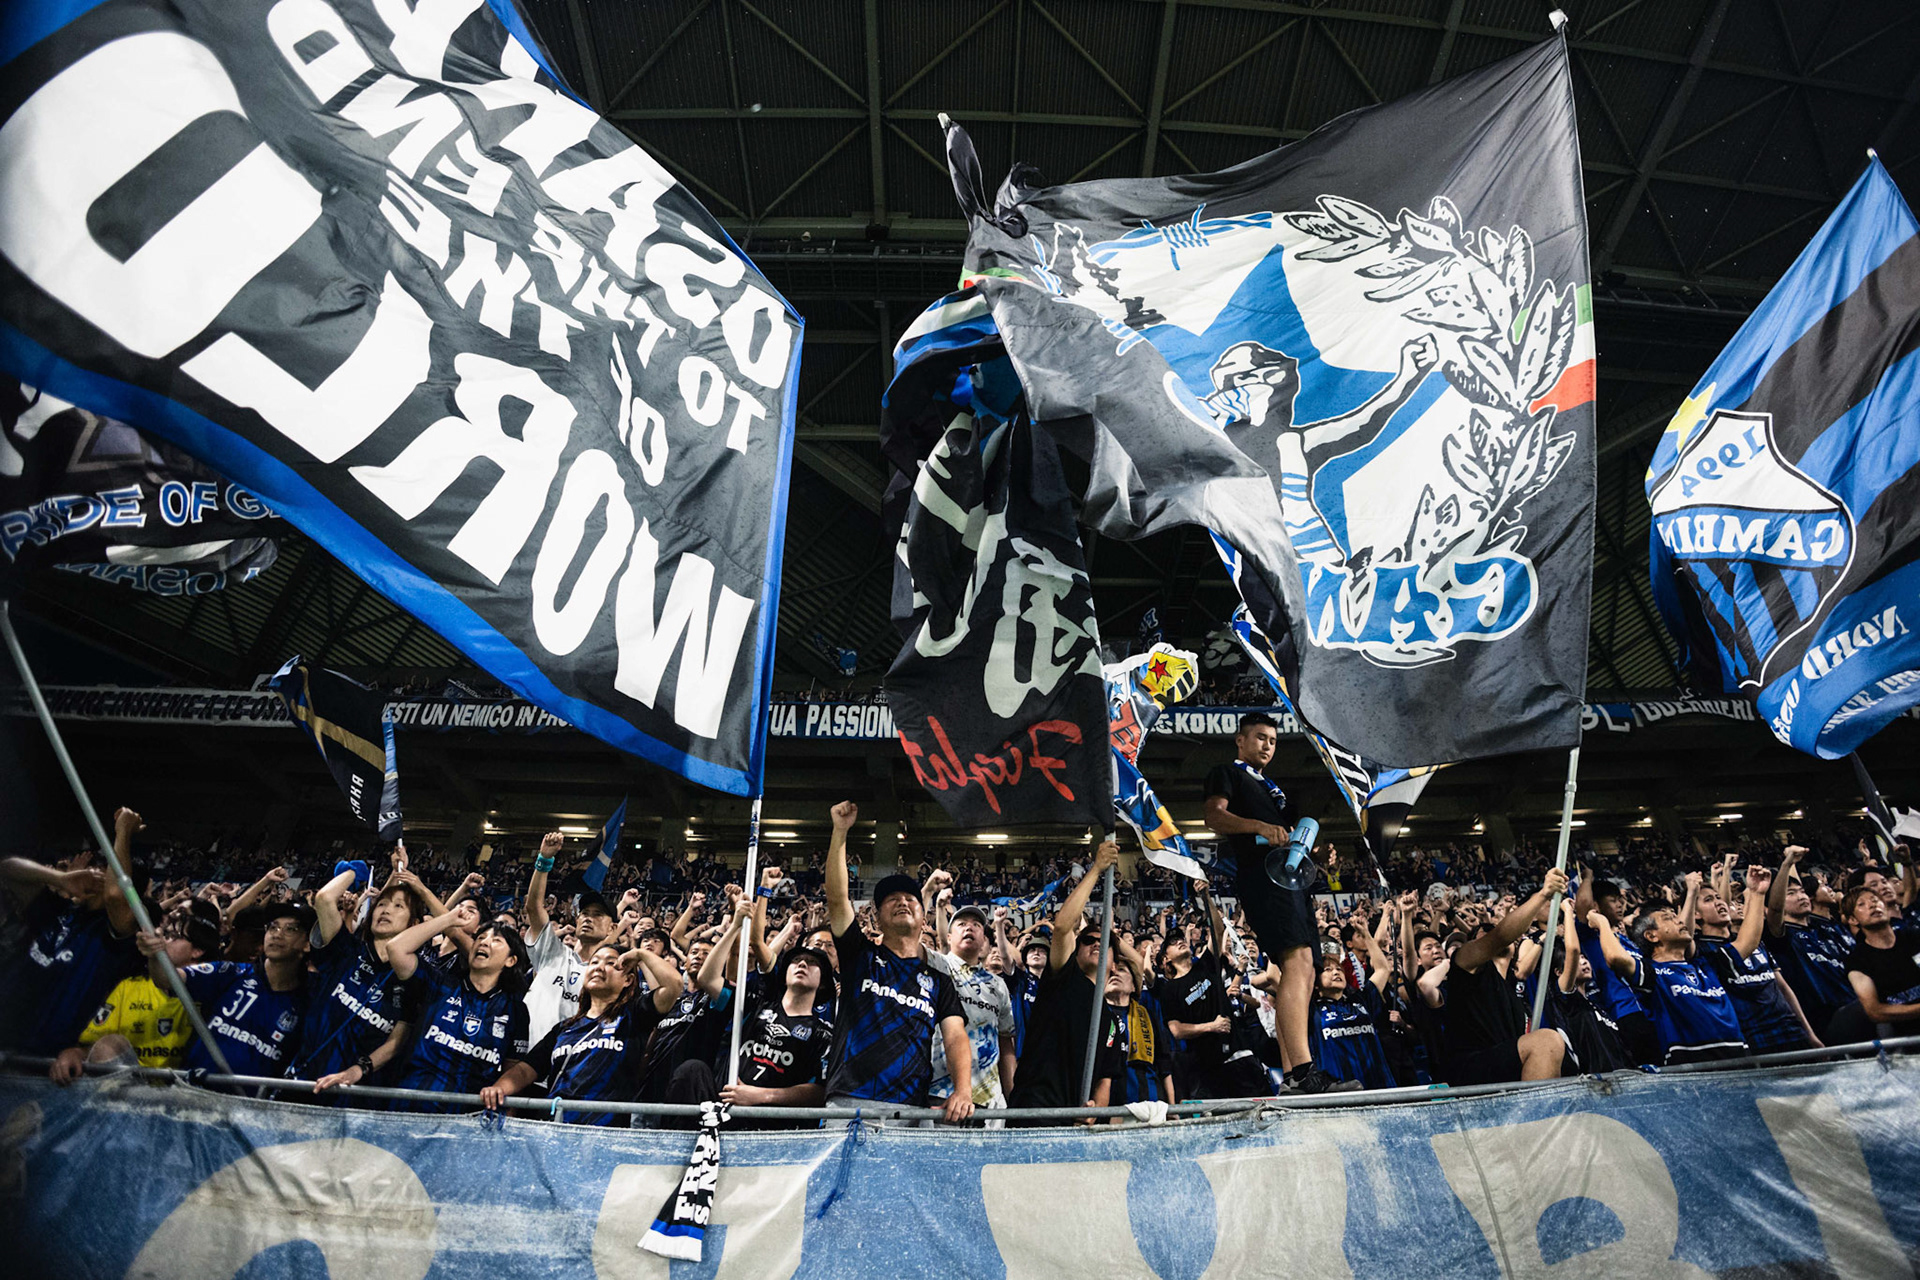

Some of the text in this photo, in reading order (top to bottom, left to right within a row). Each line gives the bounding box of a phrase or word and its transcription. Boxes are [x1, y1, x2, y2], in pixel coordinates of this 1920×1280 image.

[159, 481, 219, 526] OF
[421, 702, 445, 727] UN
[448, 704, 511, 728] NEMICO
[515, 704, 538, 728] IN
[221, 989, 259, 1021] 37
[861, 978, 936, 1019] Panasonic
[207, 1015, 284, 1062] Panasonic
[424, 1024, 501, 1066] Panasonic
[752, 1065, 767, 1081] 7
